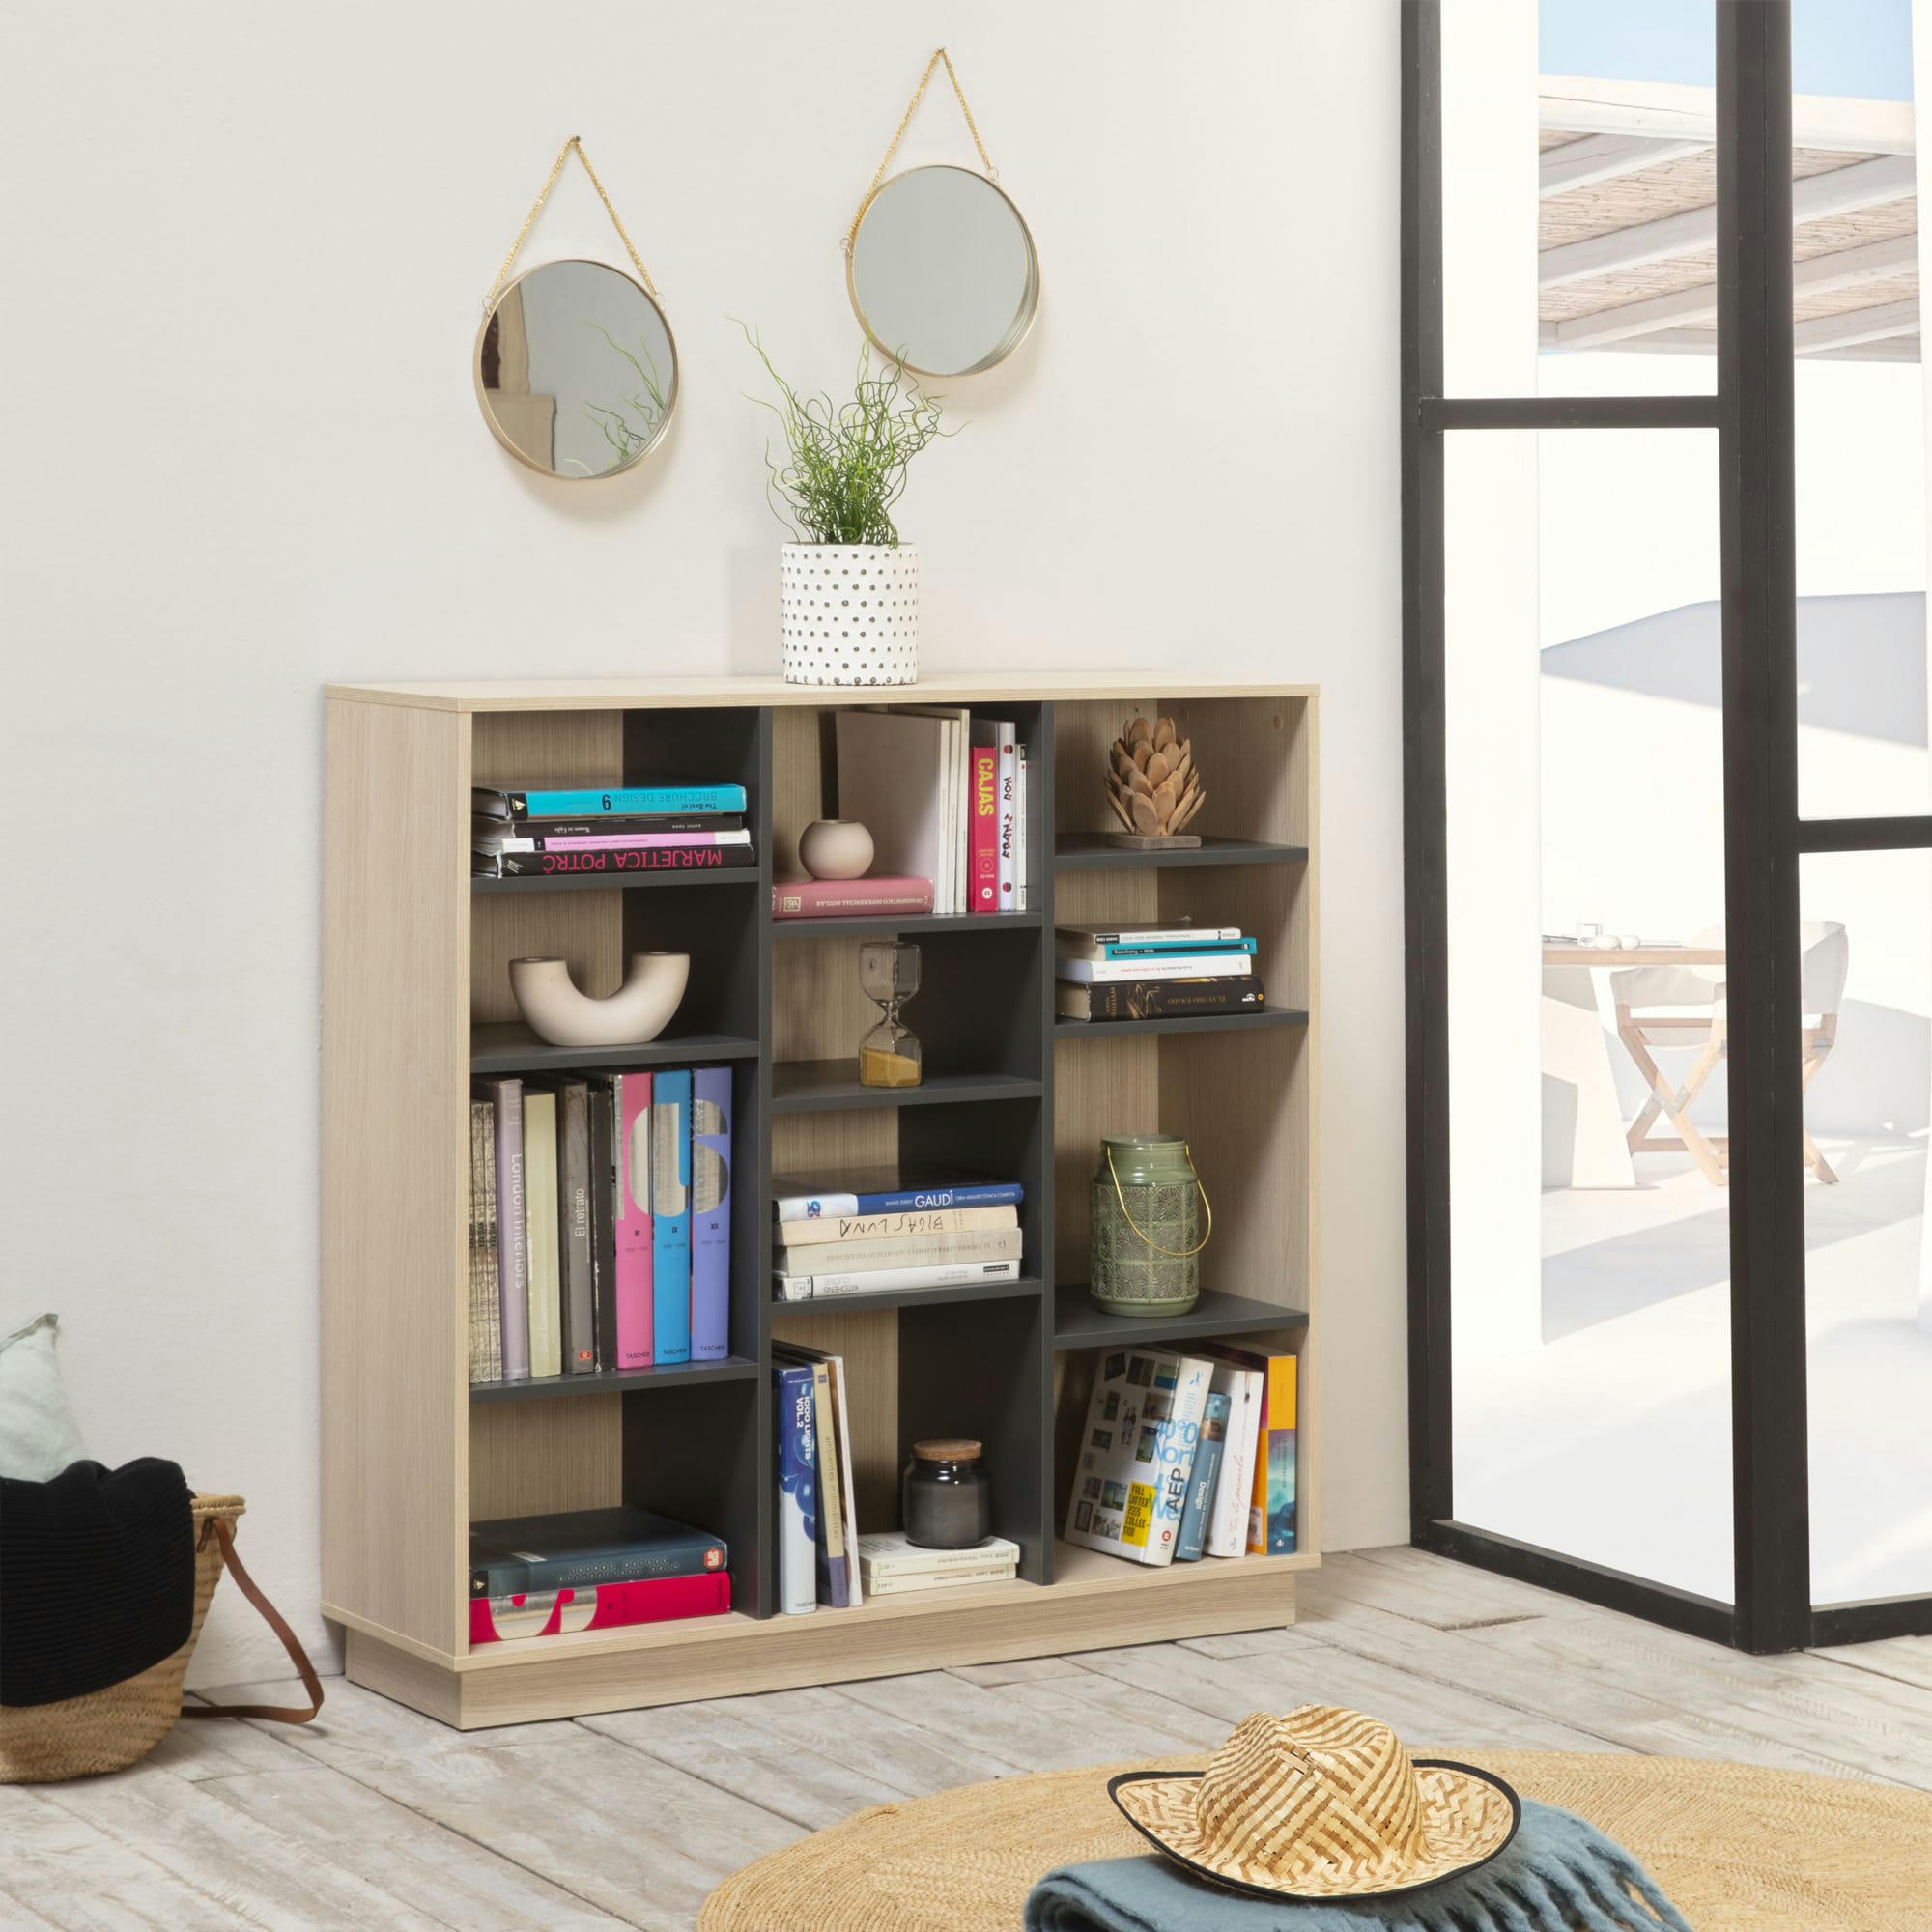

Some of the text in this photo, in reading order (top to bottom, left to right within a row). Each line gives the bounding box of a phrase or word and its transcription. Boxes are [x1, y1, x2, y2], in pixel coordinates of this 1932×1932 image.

[657, 790, 718, 803] BROCHURE
[978, 758, 994, 817] CAJAS
[601, 794, 612, 811] 9
[613, 792, 653, 805] DESIGN
[680, 803, 689, 811] of
[542, 852, 608, 876] POTRČ
[613, 849, 724, 869] MARJETICA
[915, 1190, 953, 1208] GAUDÍ
[510, 1153, 526, 1290] London Interiors
[574, 1188, 586, 1238] El retrato
[839, 1218, 888, 1238] LUNA
[895, 1214, 944, 1233] BIGAS
[823, 1285, 859, 1294] KITCHENS
[825, 1437, 839, 1540] ambientes minimalistas
